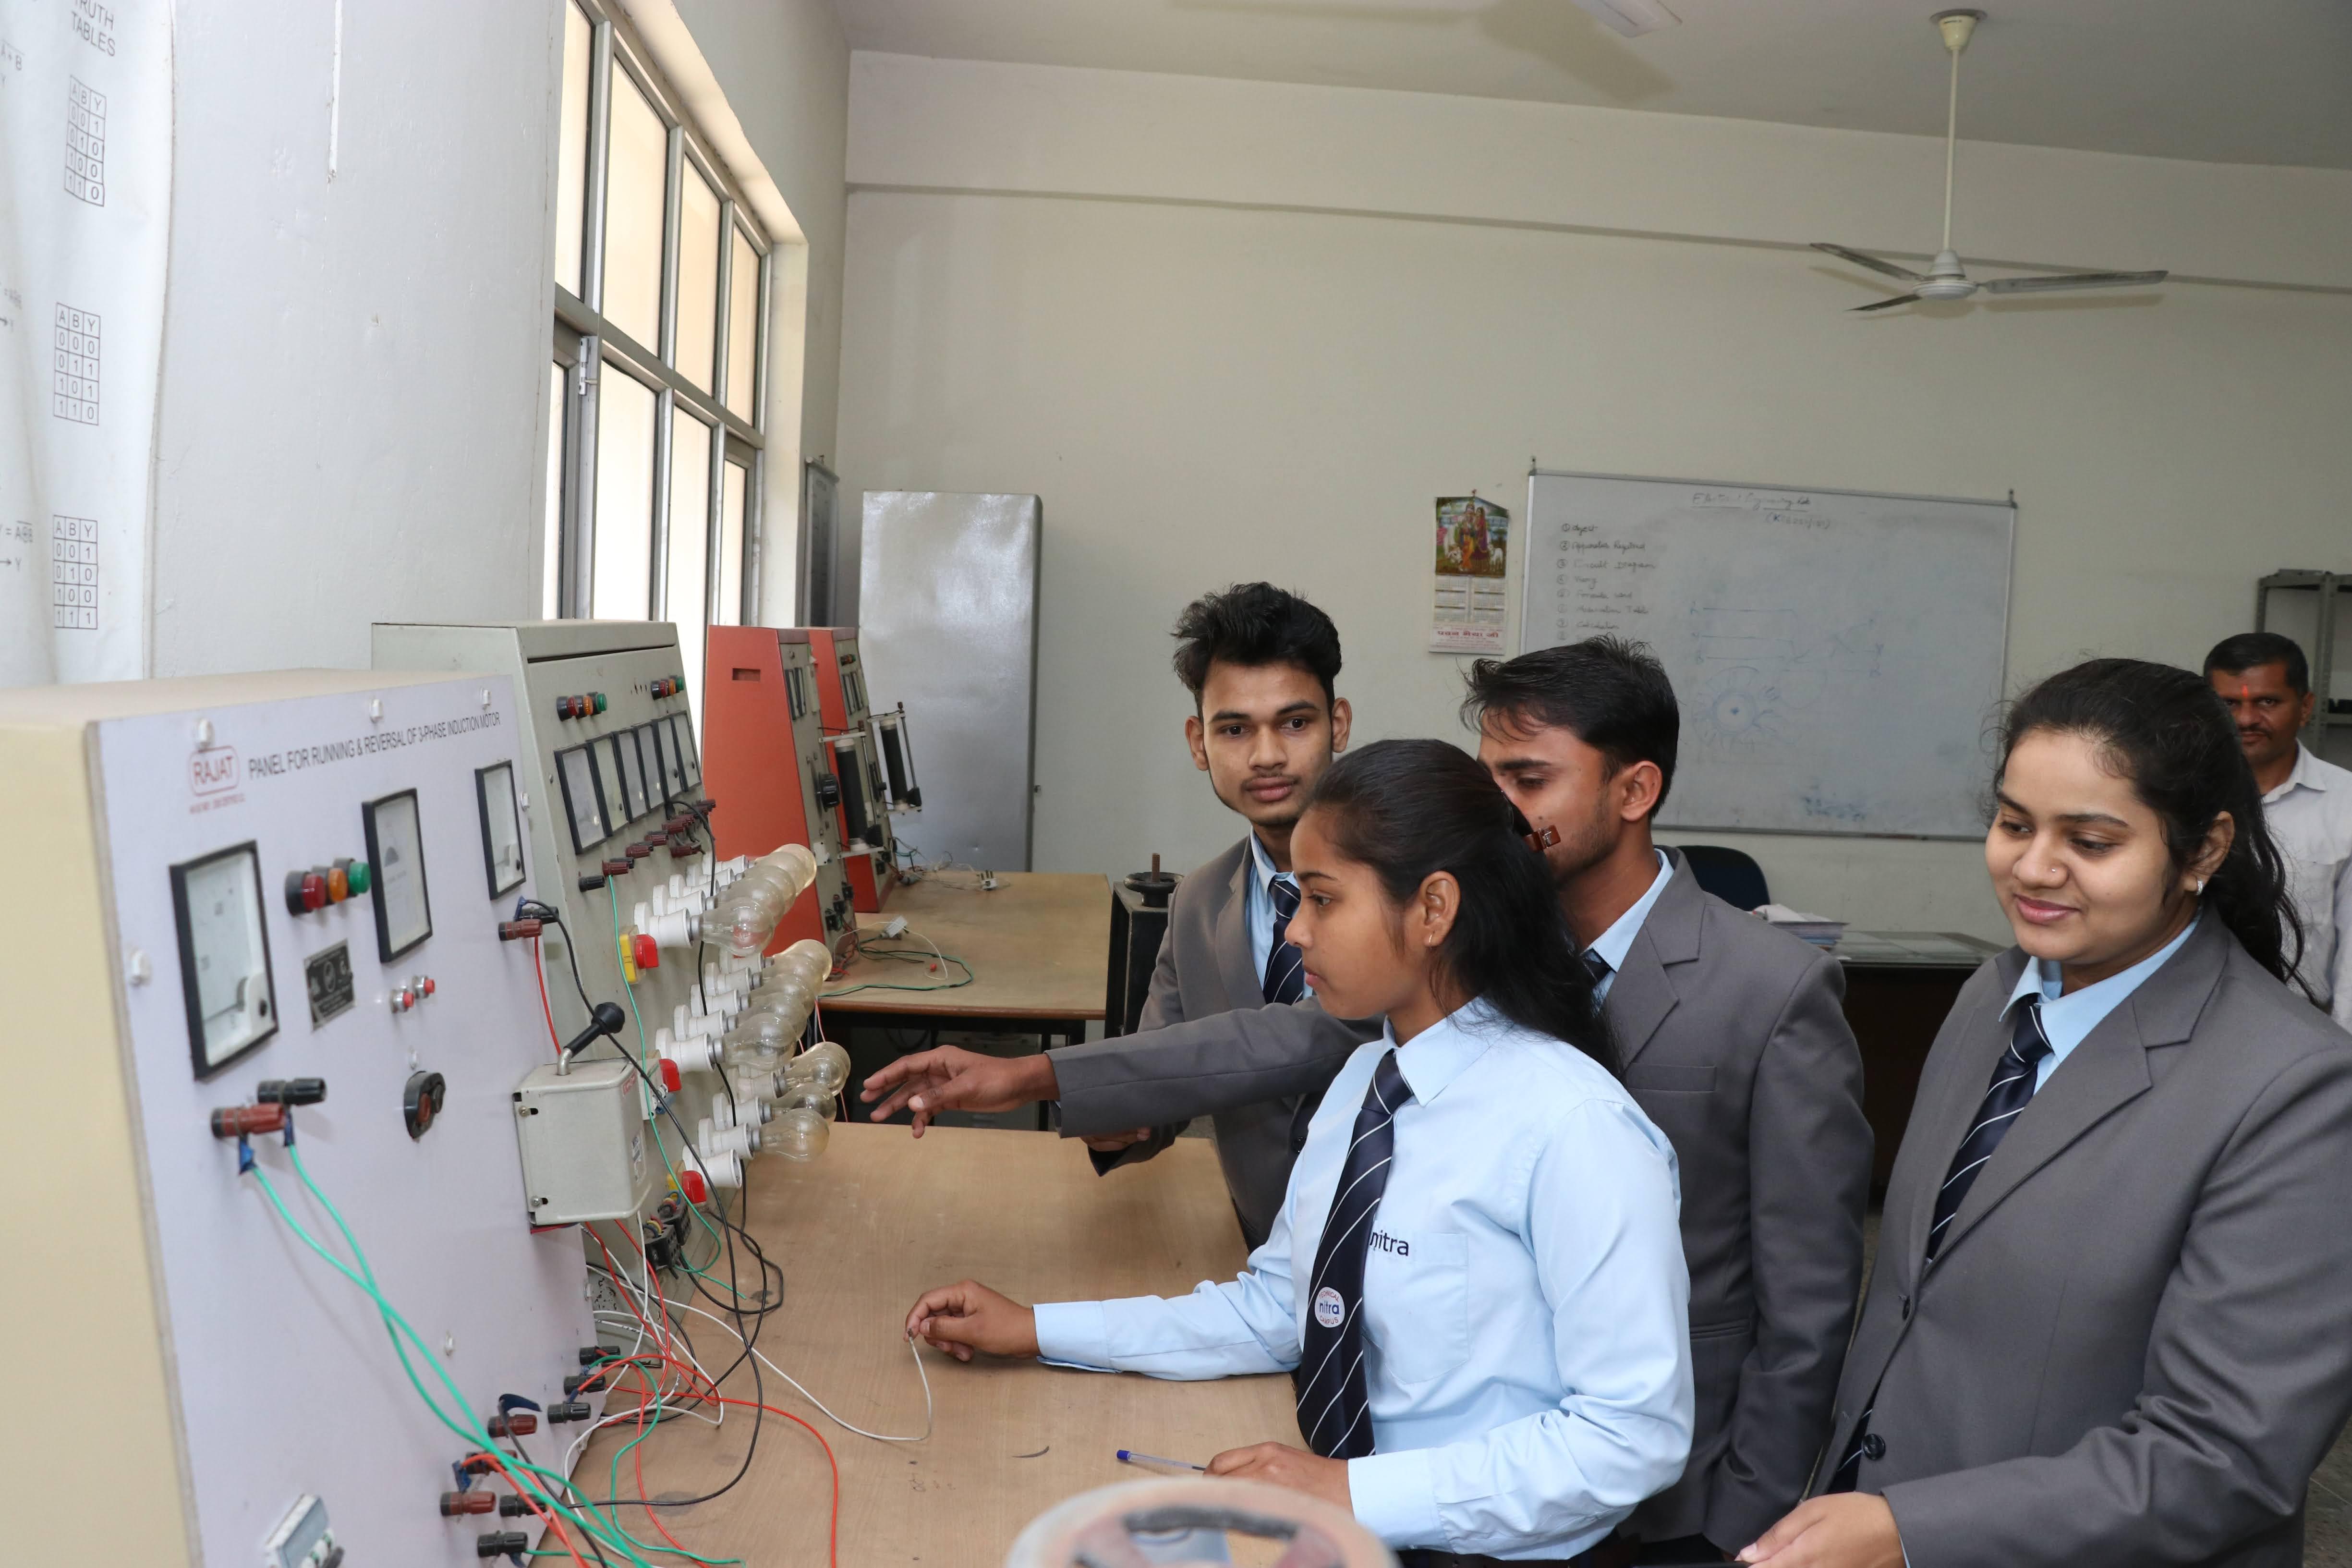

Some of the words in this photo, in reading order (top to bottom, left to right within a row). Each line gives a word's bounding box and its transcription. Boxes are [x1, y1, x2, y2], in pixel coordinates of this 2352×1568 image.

[75, 0, 114, 31] RUTH
[72, 10, 115, 57] TABLES
[73, 84, 77, 94] A
[81, 90, 87, 105] B
[95, 97, 102, 111] Y
[72, 106, 76, 117] 0
[81, 113, 85, 127] 0
[70, 129, 75, 143] 0
[92, 142, 98, 156] 0
[78, 158, 83, 171] 0
[91, 164, 97, 178] 0
[91, 186, 99, 200] 0
[59, 311, 65, 324] A
[73, 314, 80, 328] B
[88, 318, 96, 332] Y
[60, 332, 65, 346] 0
[73, 336, 79, 350] 0
[88, 340, 95, 354] 0
[59, 354, 64, 368] 0
[72, 381, 78, 394] 0
[88, 407, 94, 420] 0
[56, 521, 62, 535] A
[69, 523, 76, 536] B
[85, 524, 92, 538] Y
[57, 543, 61, 557] 0
[69, 545, 75, 558] 0
[57, 565, 61, 579] 0
[85, 568, 92, 581] 0
[69, 588, 75, 602] 0
[85, 590, 91, 603] 0
[248, 754, 286, 779] PANEL
[287, 748, 310, 770] FOR
[312, 739, 355, 766] RUNNING
[357, 737, 363, 756] &
[364, 730, 406, 754] REVERSAL
[408, 728, 416, 745] OF
[418, 722, 447, 742] 3-PHASE
[448, 715, 480, 736] INDUCTION
[480, 712, 501, 728] MOTOR
[193, 755, 233, 786] RAJAT
[1370, 1229, 1409, 1256] nitra
[1319, 1290, 1339, 1302] TECHNICAL
[1320, 1301, 1339, 1314] nitra
[1320, 1315, 1339, 1325] CAMPUS
